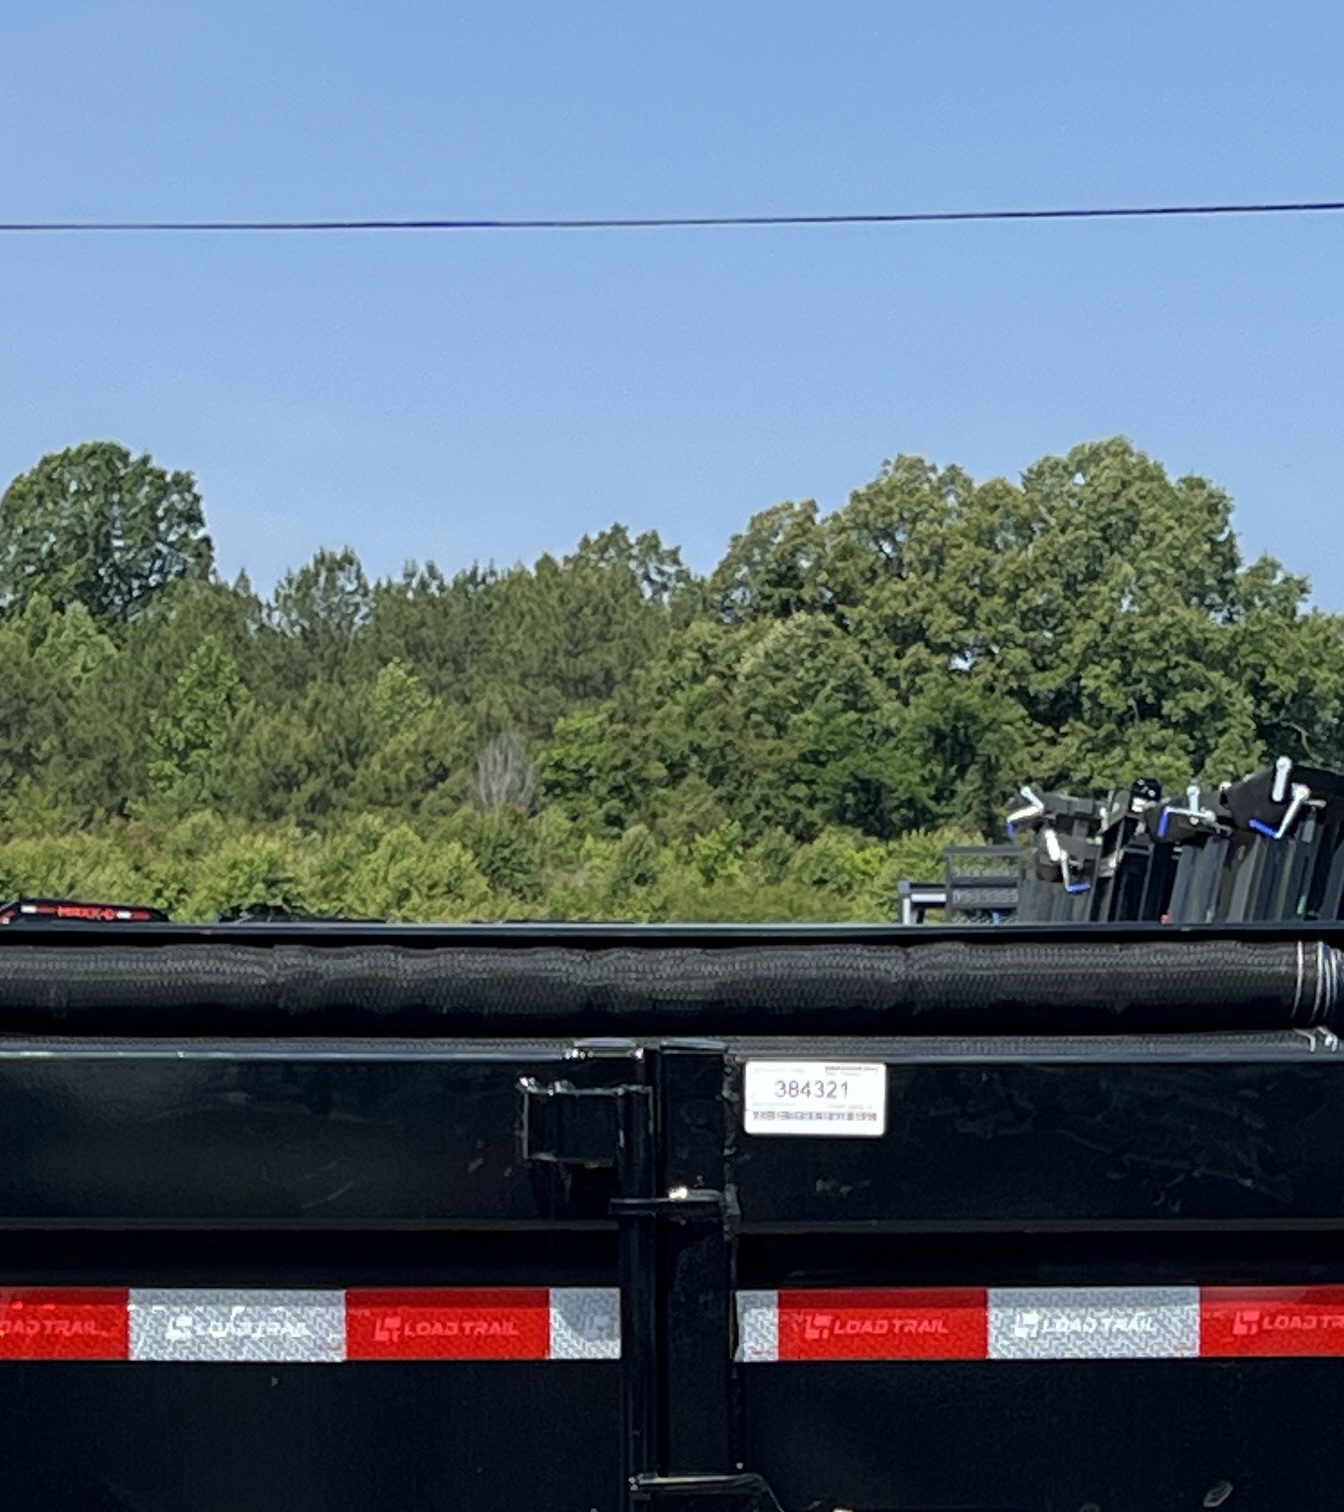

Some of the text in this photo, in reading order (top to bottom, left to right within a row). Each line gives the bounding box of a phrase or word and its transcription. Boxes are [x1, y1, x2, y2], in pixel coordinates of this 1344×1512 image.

[774, 1080, 848, 1098] 384321
[405, 1321, 520, 1336] LOAD TRAIL
[833, 1317, 949, 1334] LOAD TRAIL
[1042, 1316, 1157, 1334] LOAD TRAIL
[1262, 1315, 1318, 1331] LOAD
